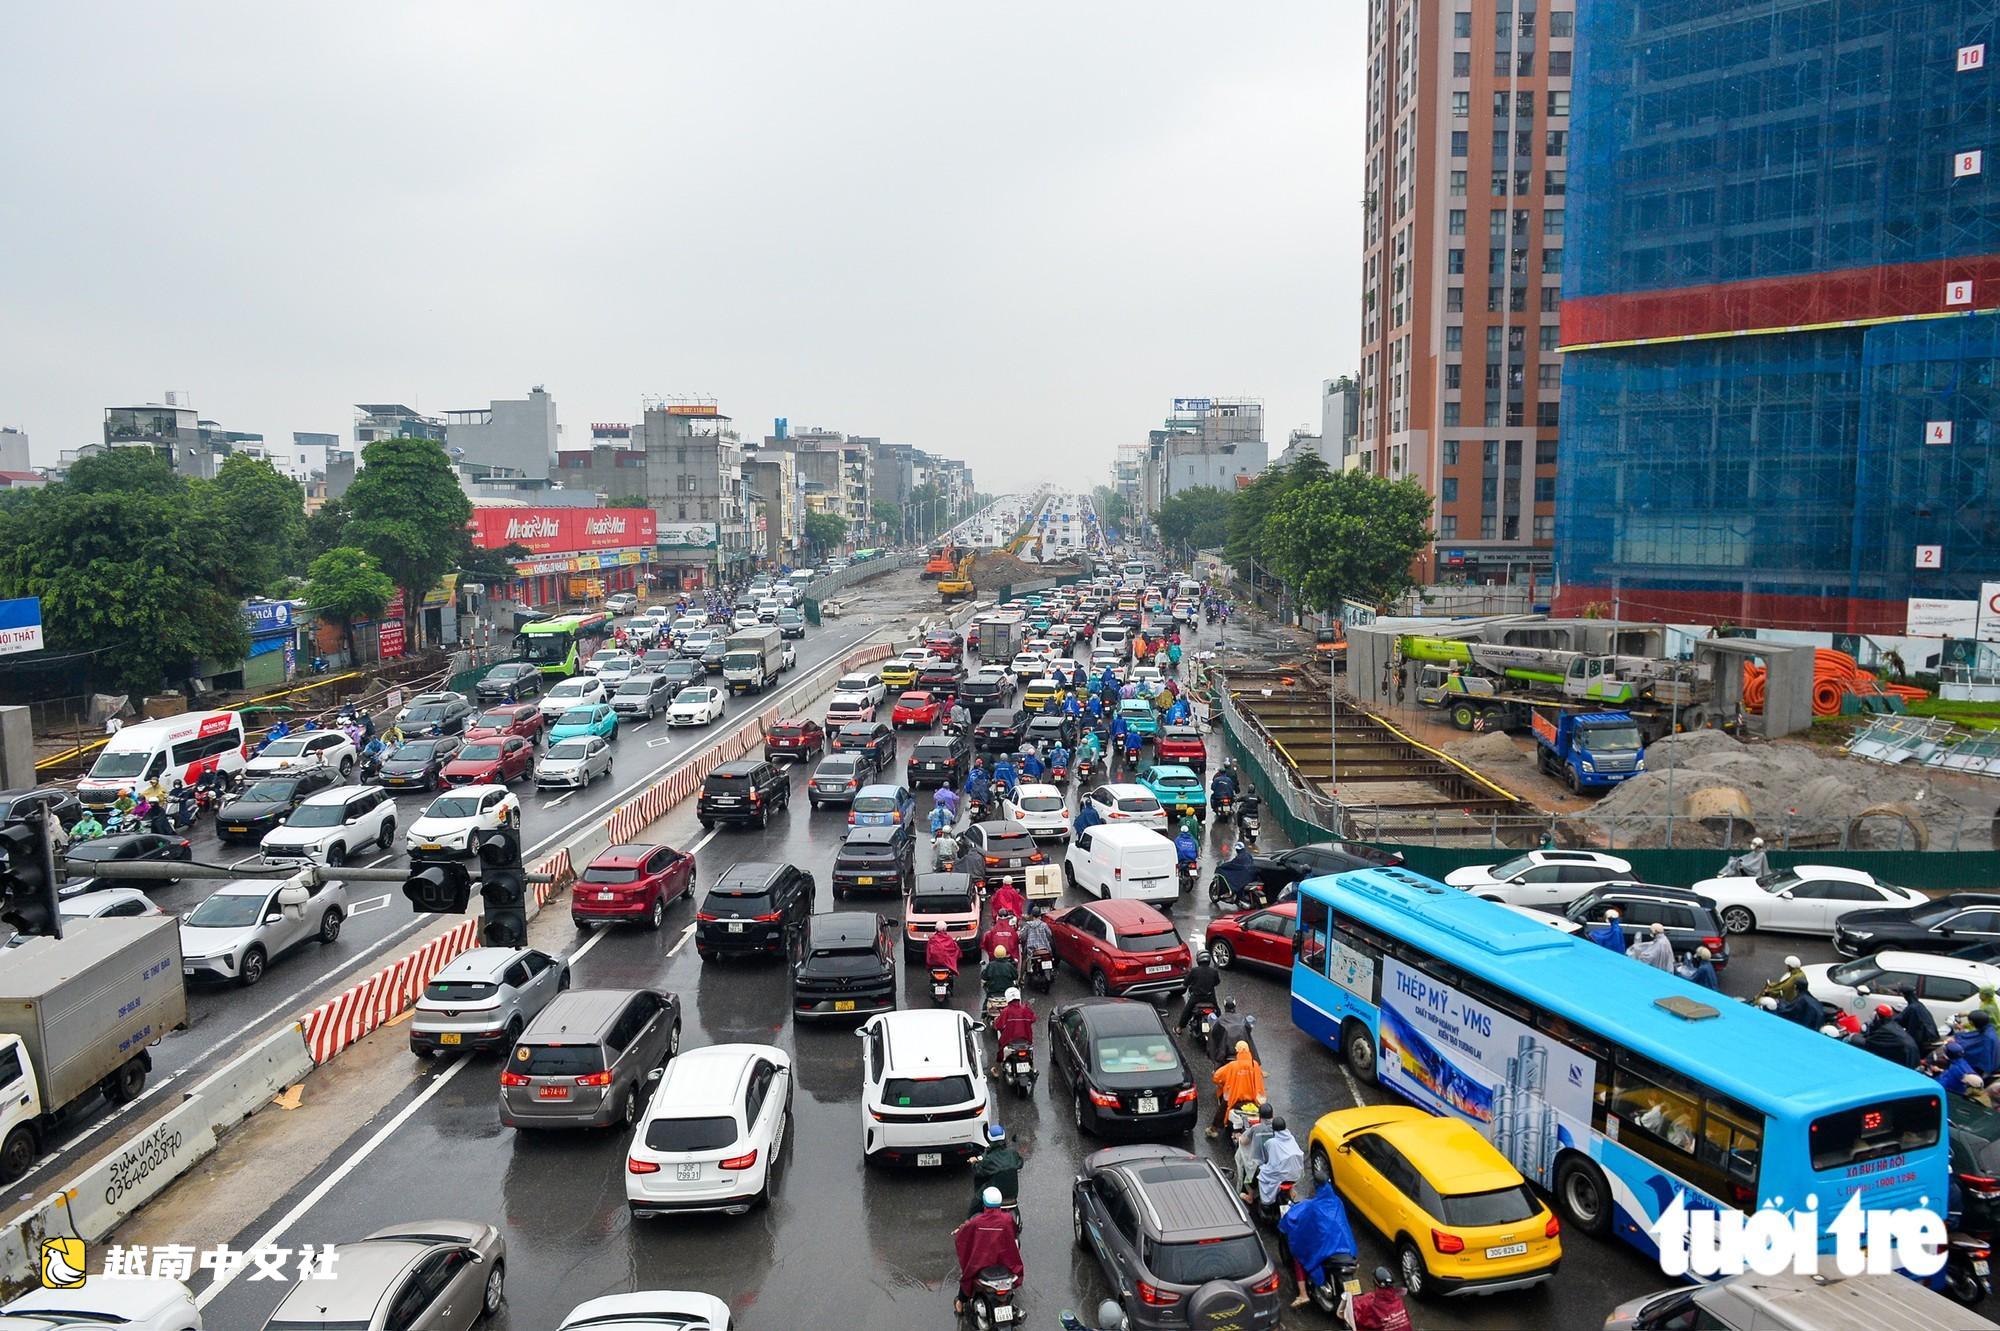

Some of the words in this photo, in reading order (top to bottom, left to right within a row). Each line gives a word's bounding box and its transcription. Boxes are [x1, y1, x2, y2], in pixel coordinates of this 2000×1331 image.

[1962, 50, 1979, 65] 10
[1964, 157, 1973, 171] 8
[1955, 286, 1964, 300] 6
[1934, 426, 1943, 439] 4
[1924, 550, 1933, 563] 2
[1396, 970, 1426, 1001] THÉP
[1428, 987, 1448, 1014] MỸ
[1462, 1004, 1492, 1038] VMS
[105, 1131, 182, 1205] 0364202870
